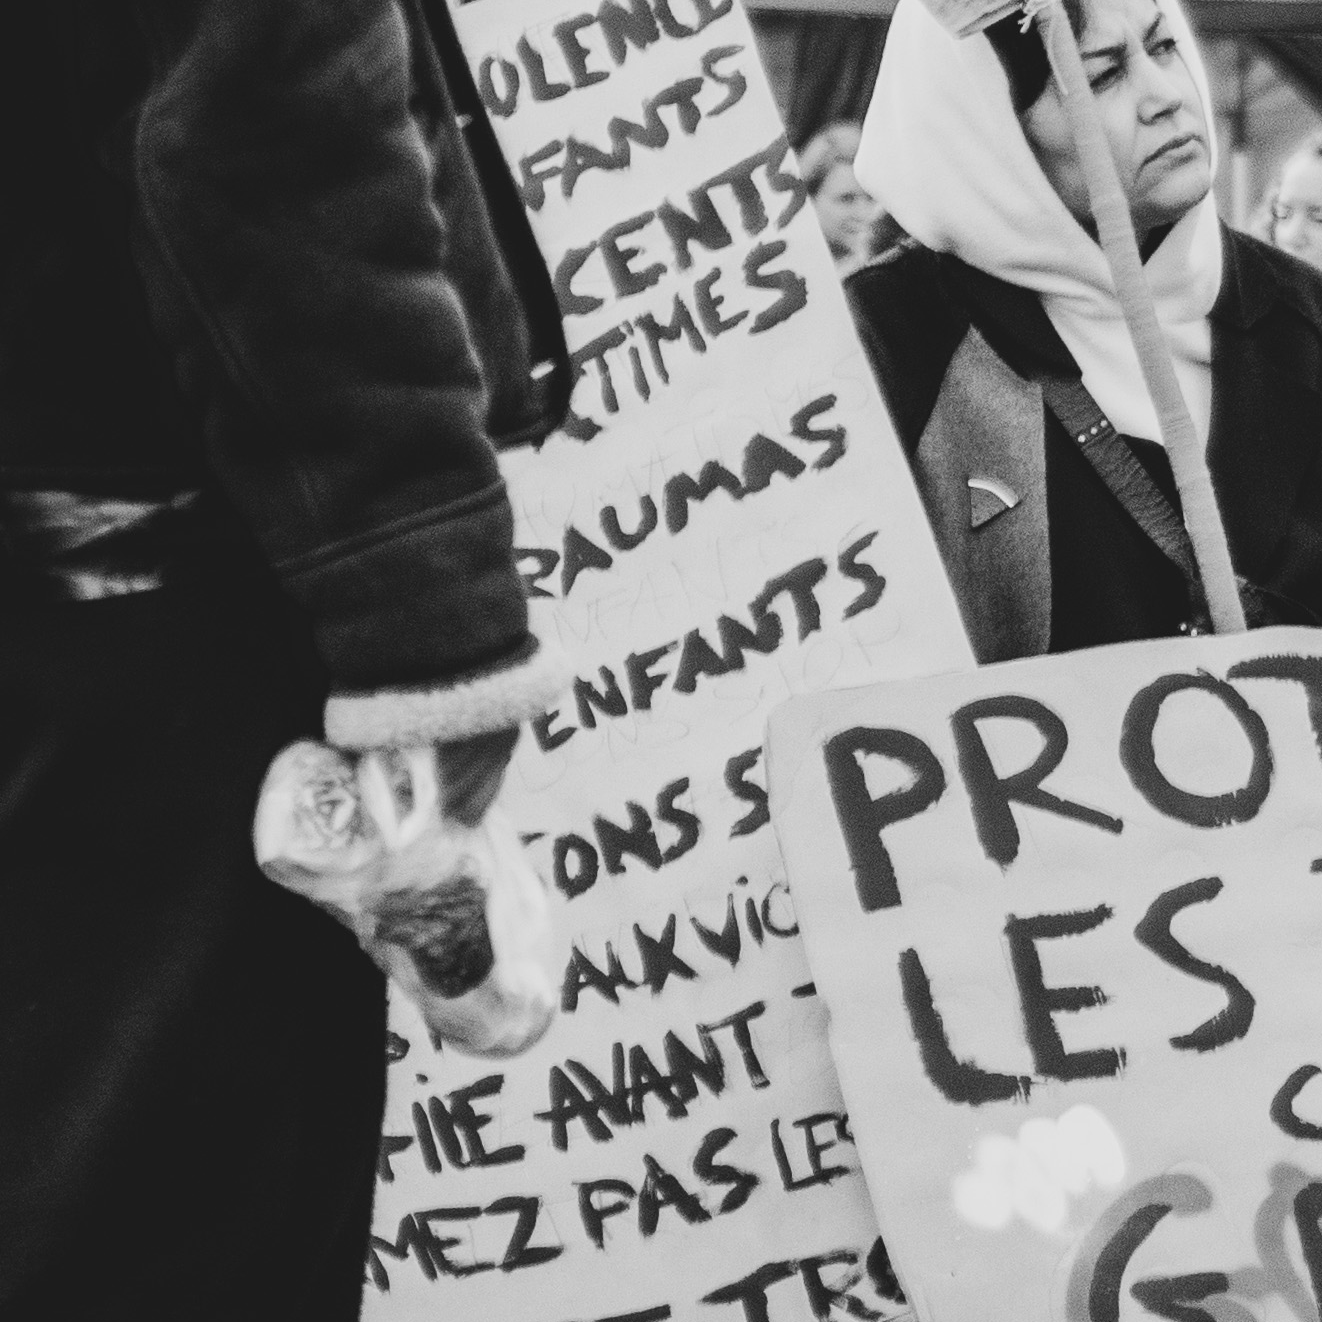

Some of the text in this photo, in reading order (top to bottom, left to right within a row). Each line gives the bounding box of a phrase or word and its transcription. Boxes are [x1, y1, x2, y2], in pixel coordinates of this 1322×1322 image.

[516, 44, 747, 212] FANTS
[551, 134, 807, 317] CENTS
[529, 529, 887, 753] ENFANTS
[519, 775, 701, 902] ONS
[896, 875, 1257, 1106] LES
[532, 999, 772, 1153] AVANT
[362, 1195, 565, 1295] MEZ
[571, 1126, 760, 1251] PAS
